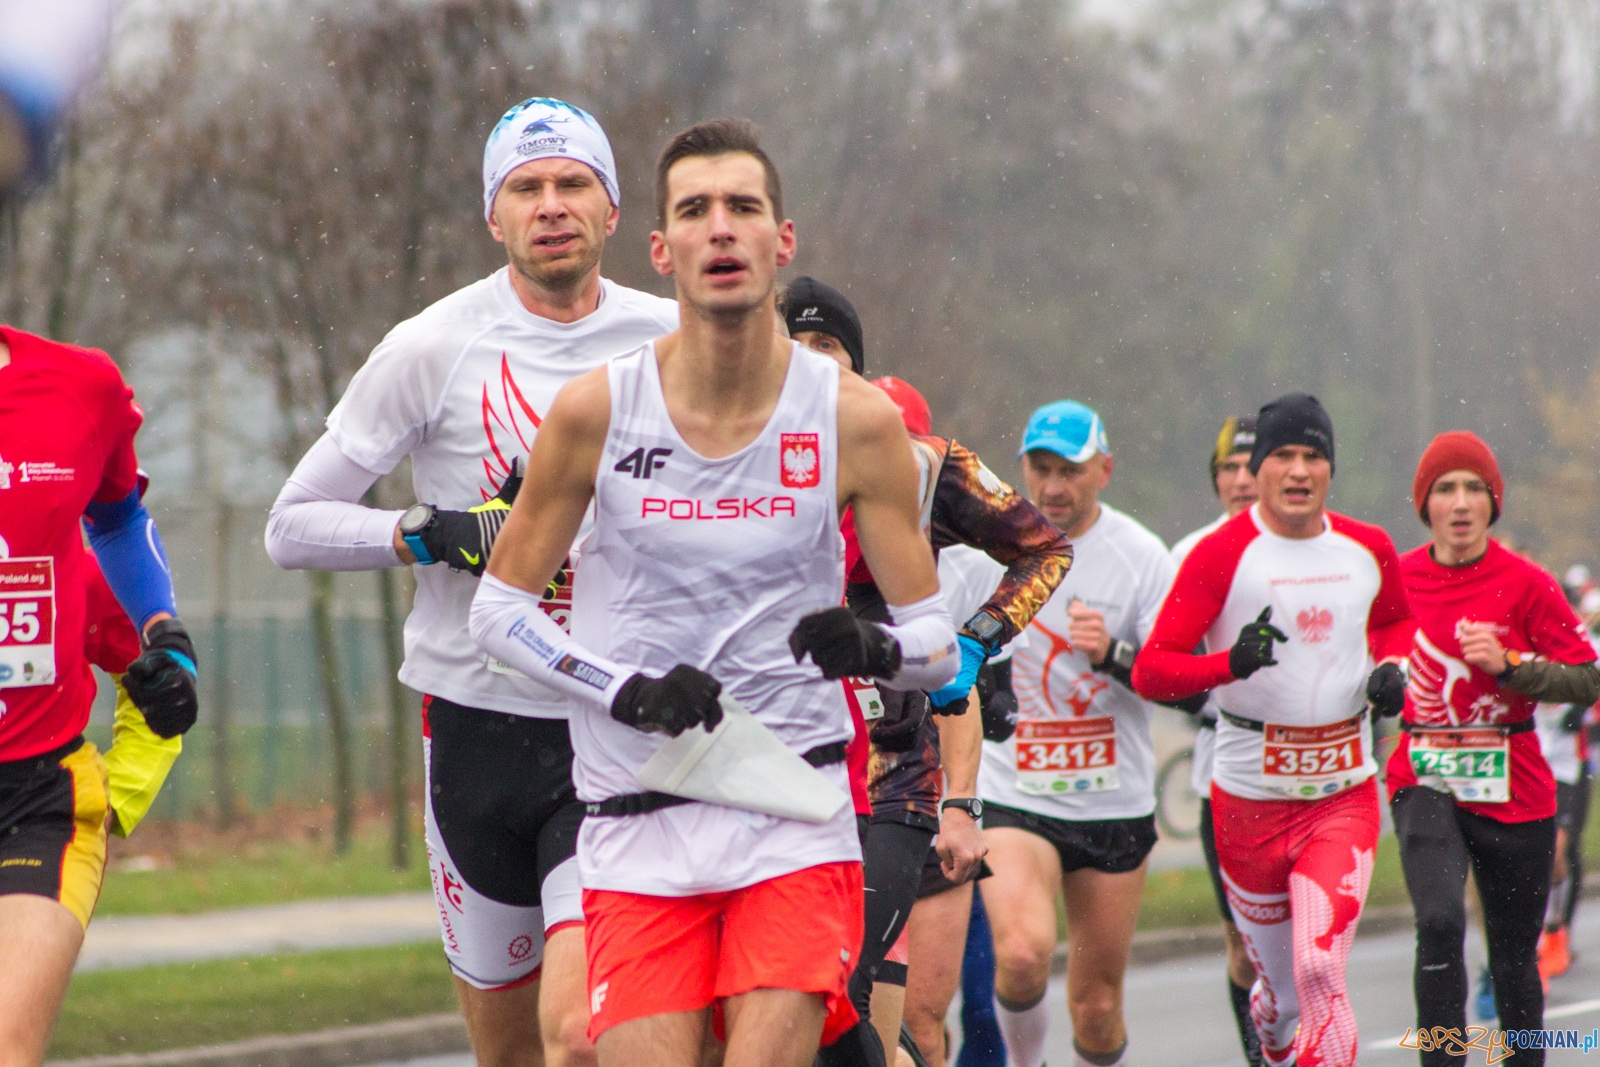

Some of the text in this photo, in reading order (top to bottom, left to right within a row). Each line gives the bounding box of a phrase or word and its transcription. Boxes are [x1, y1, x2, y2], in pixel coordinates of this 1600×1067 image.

[782, 434, 817, 443] POLSKA
[614, 447, 673, 479] 4F
[641, 496, 796, 520] POLSKA
[1029, 741, 1107, 769] 3412
[1278, 742, 1352, 774] 3521
[1421, 752, 1495, 776] 2514
